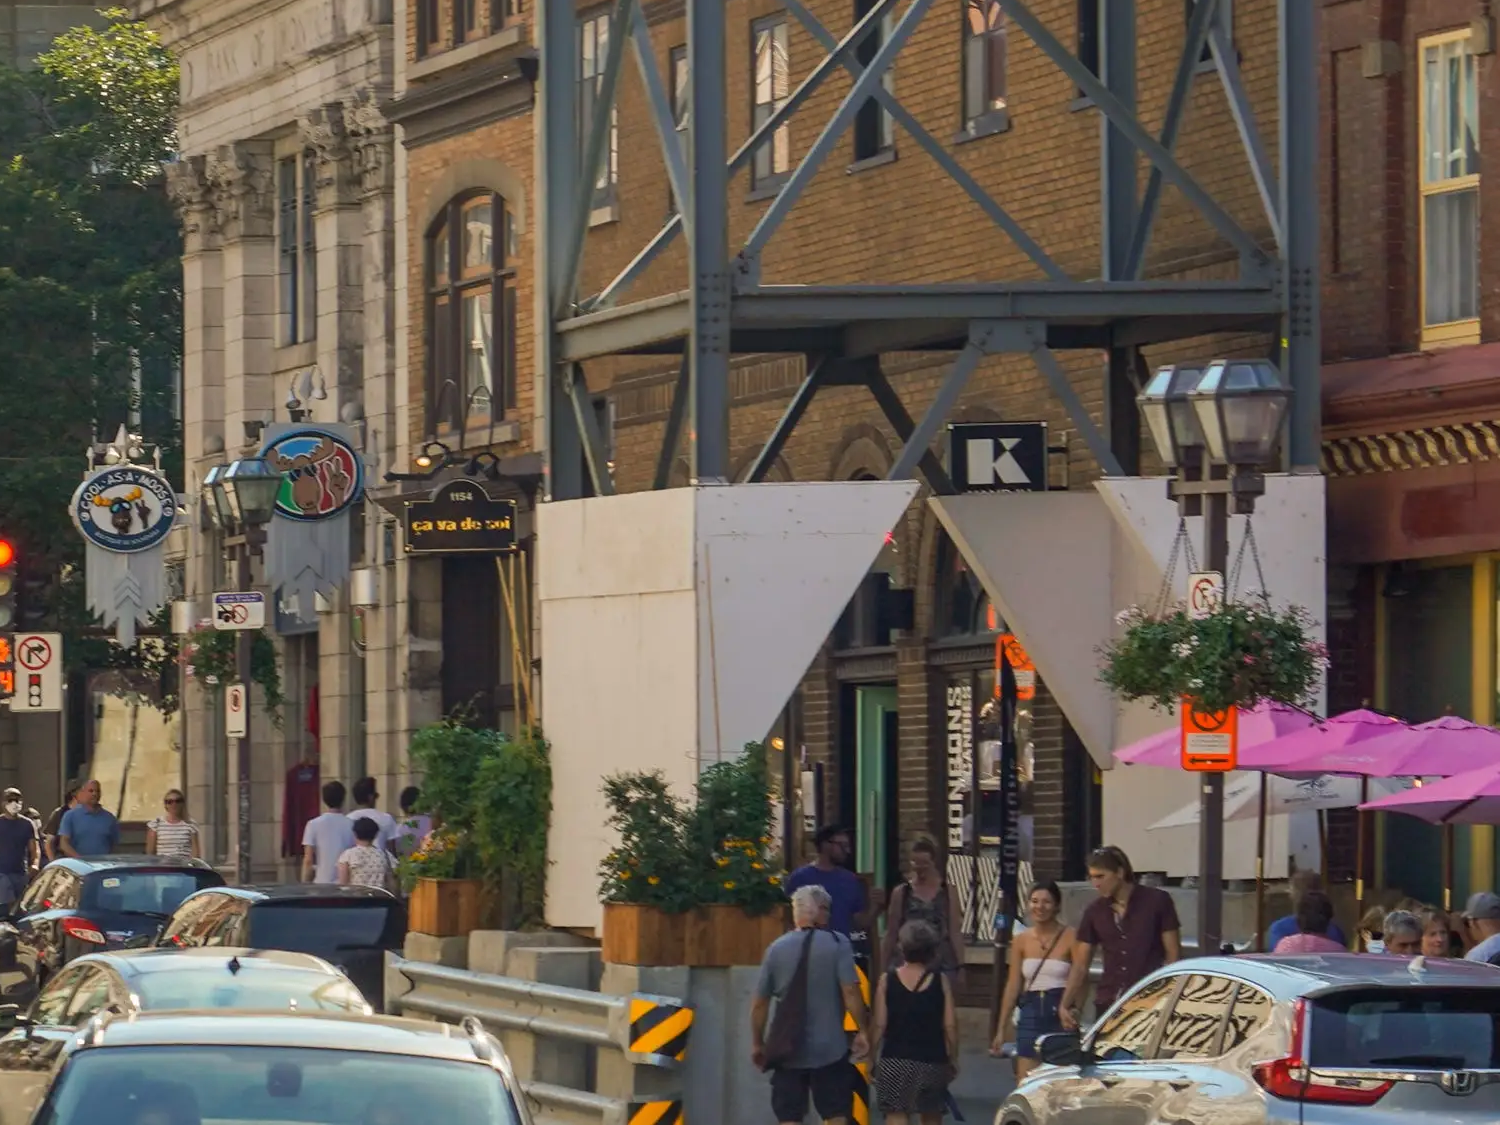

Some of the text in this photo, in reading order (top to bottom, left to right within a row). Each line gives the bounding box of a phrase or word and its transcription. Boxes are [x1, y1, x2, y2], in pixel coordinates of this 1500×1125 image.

[965, 437, 1032, 485] K
[449, 492, 473, 501] 1154
[411, 515, 511, 536] ça va de soi
[947, 686, 963, 848] BONBONS
